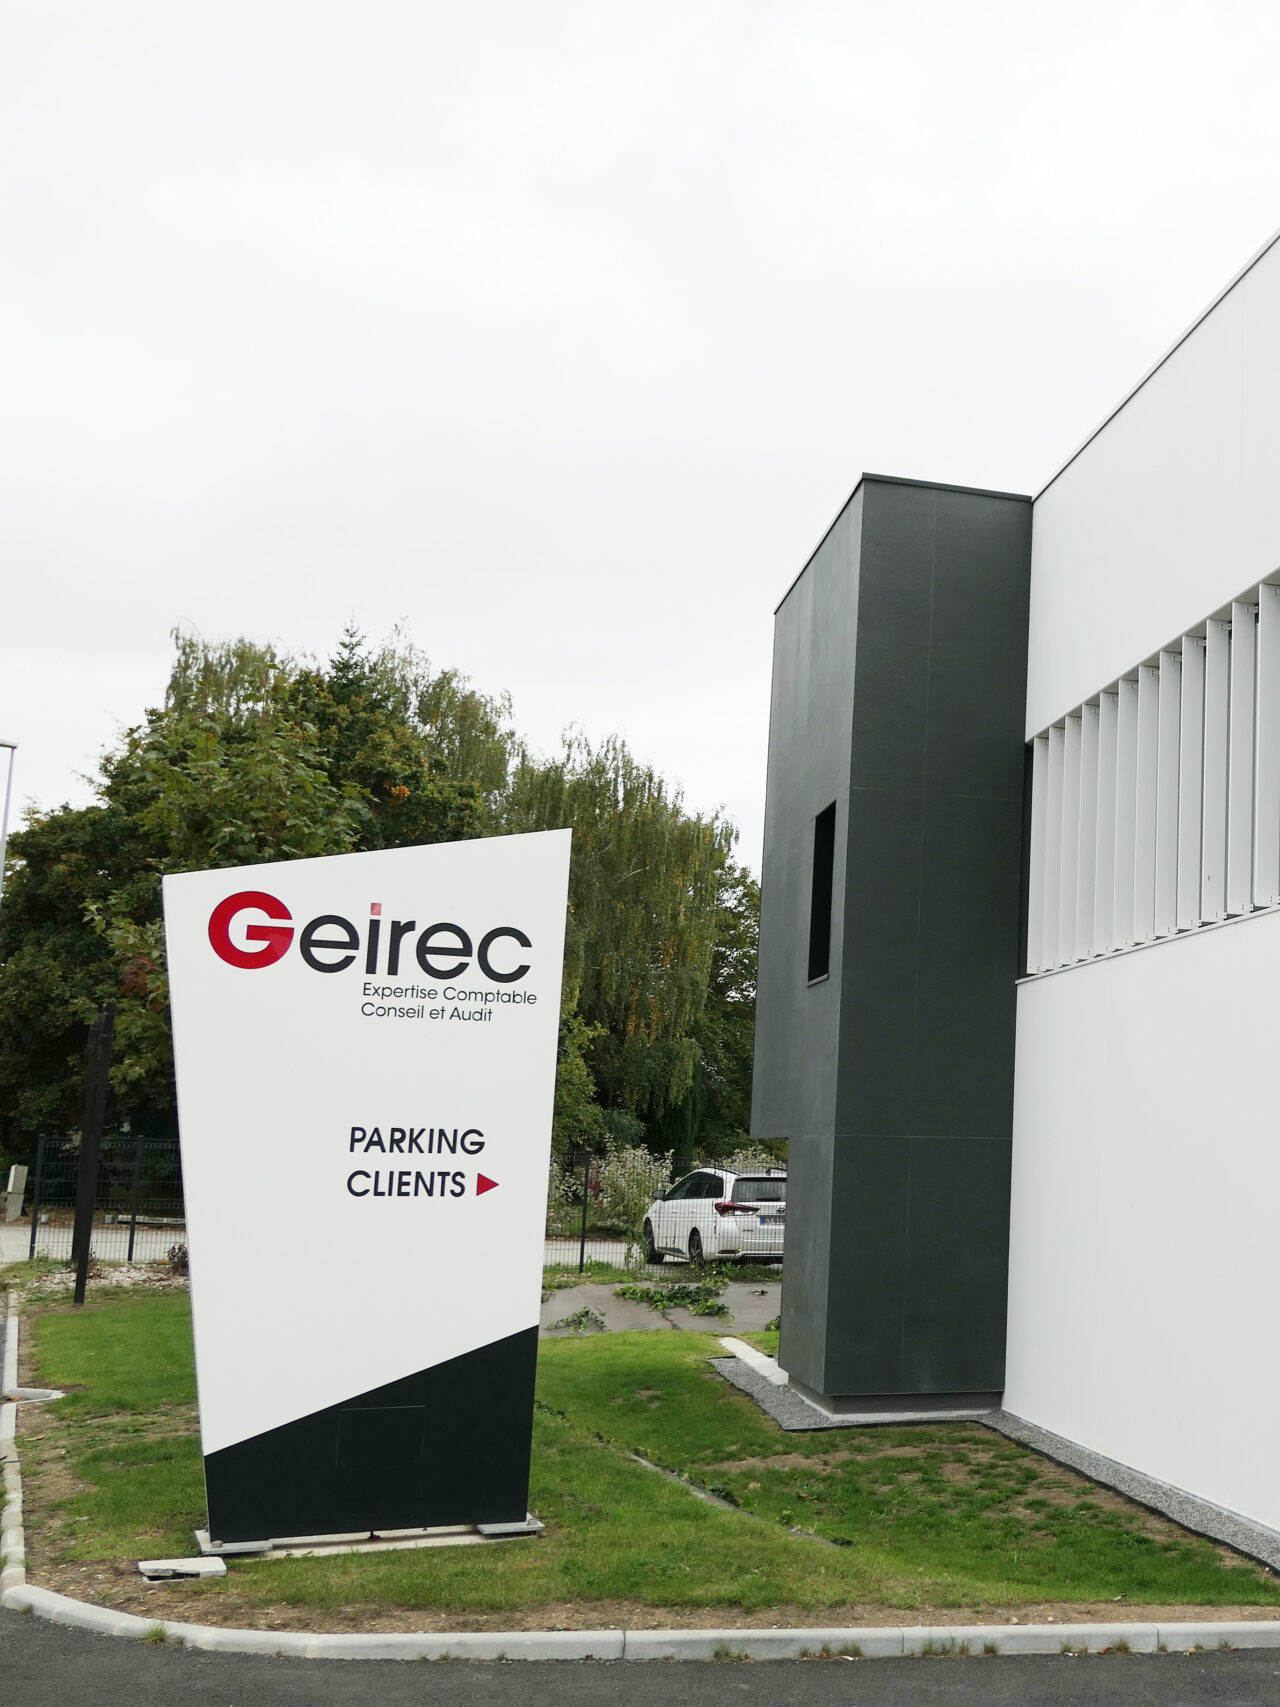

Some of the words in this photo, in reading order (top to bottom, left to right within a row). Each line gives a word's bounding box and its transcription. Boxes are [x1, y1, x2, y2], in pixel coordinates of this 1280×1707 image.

[208, 891, 533, 983] Geirec
[362, 983, 438, 1000] Expertise
[443, 986, 537, 1005] Comptable
[361, 1002, 424, 1019] Conseil
[429, 1006, 446, 1020] et
[449, 1007, 493, 1022] Audit
[349, 1127, 486, 1155] PARKING
[347, 1170, 465, 1198] CLIENTS
